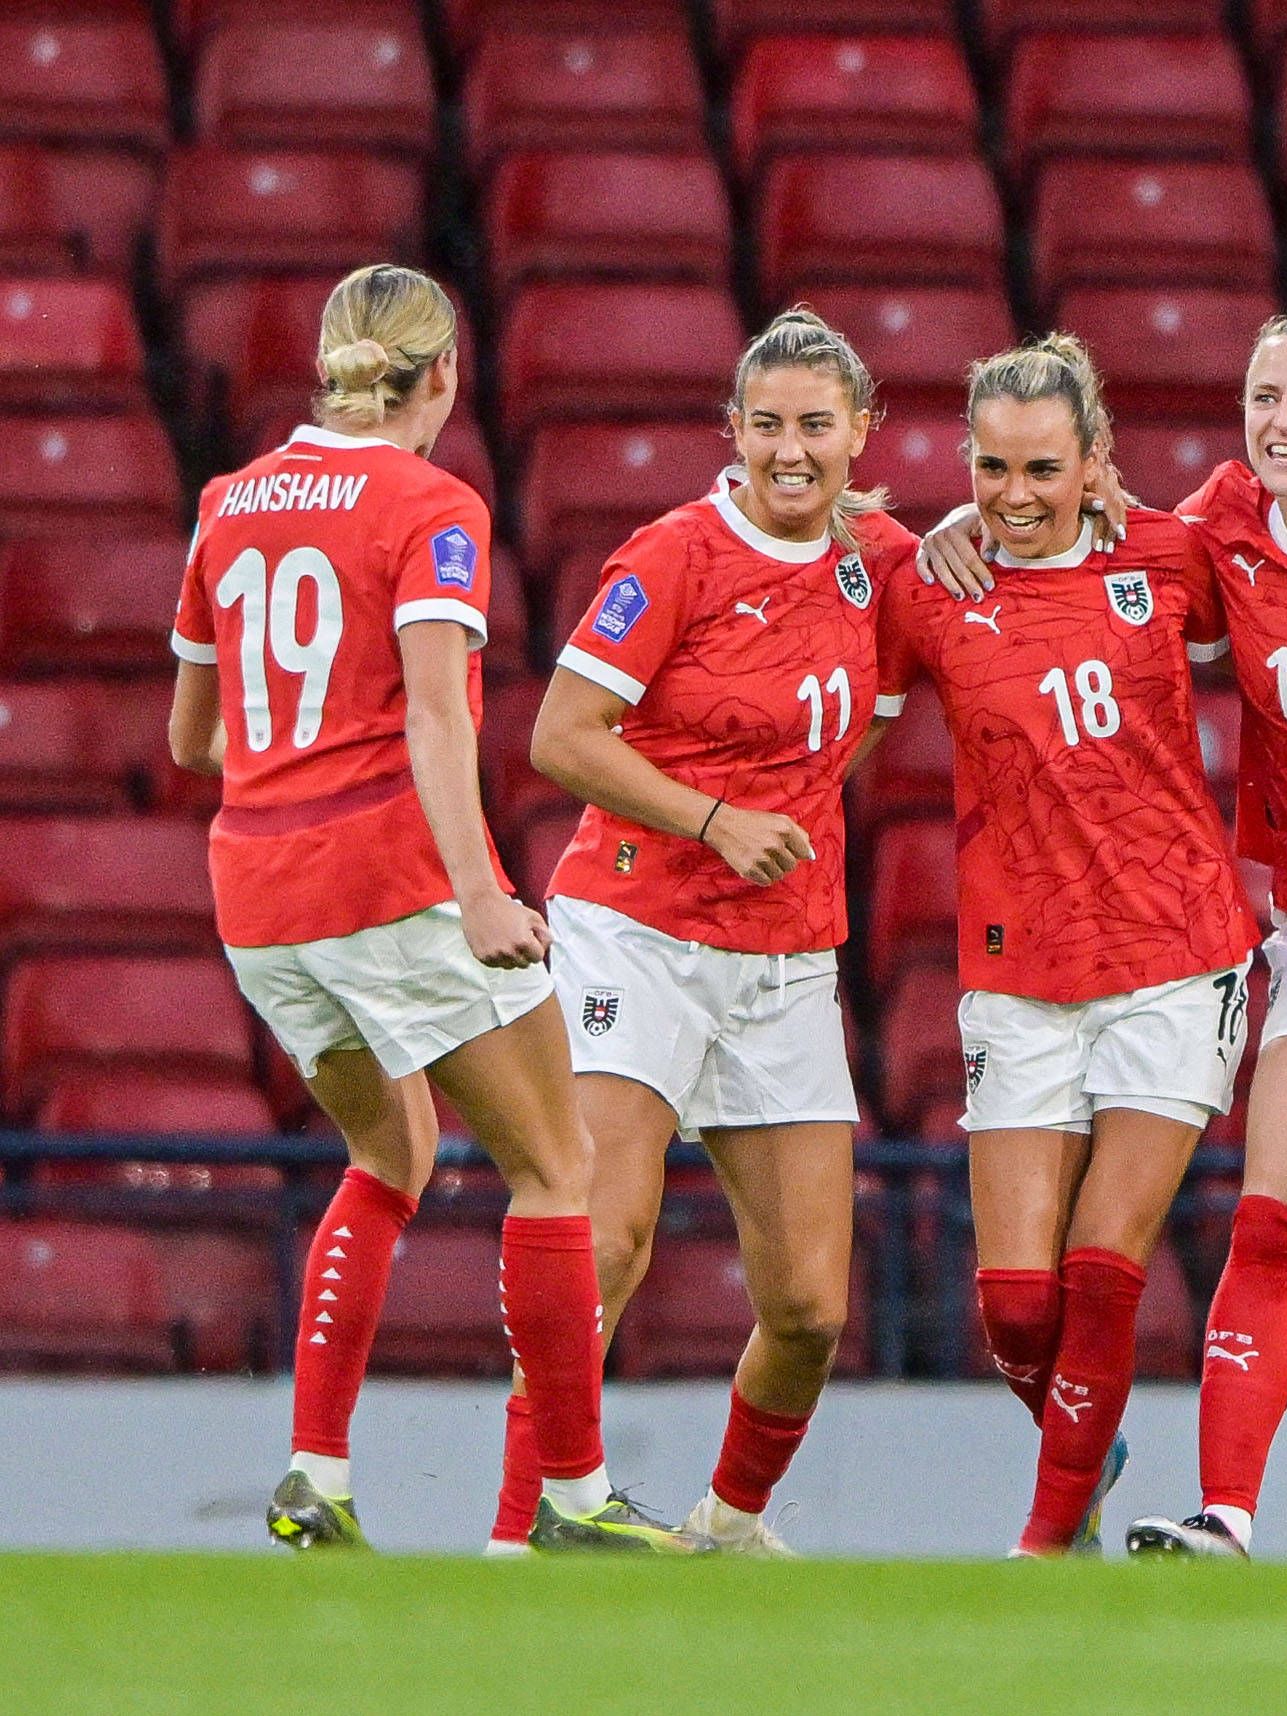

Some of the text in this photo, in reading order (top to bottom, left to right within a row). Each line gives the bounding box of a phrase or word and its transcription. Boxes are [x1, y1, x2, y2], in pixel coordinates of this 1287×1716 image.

[216, 472, 369, 518] HANSHAW
[215, 546, 344, 753] 19
[796, 666, 851, 752] 11
[1038, 659, 1121, 747] 18
[1212, 971, 1247, 1046] 18
